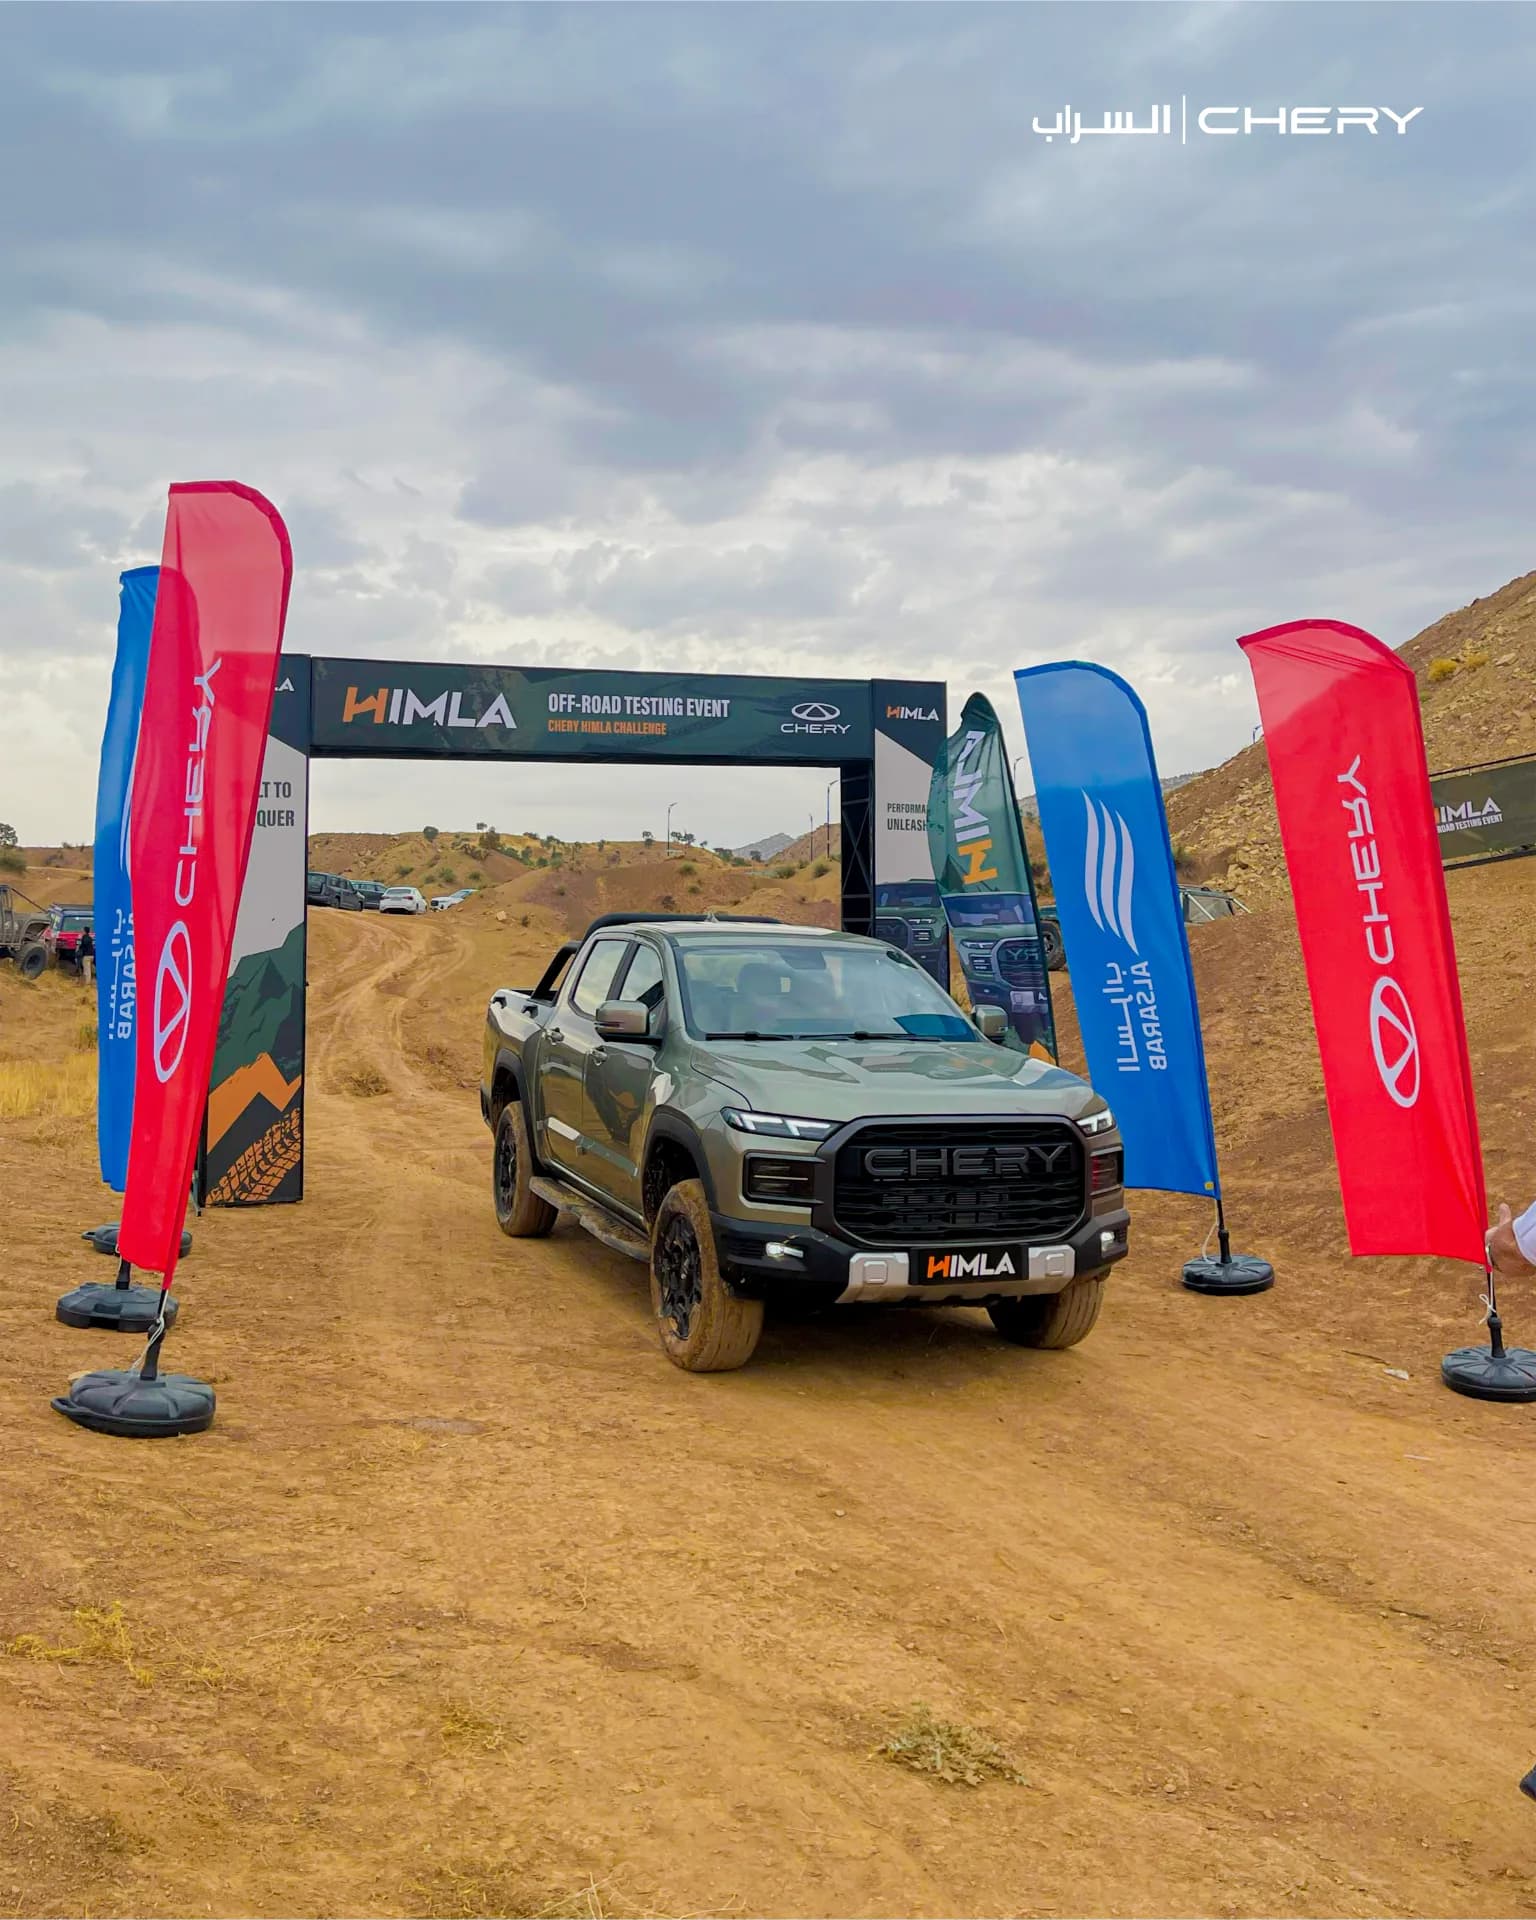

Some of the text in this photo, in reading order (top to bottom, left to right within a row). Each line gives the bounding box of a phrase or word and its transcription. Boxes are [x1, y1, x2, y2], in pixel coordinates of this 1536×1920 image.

[342, 686, 518, 729] HIMLA
[548, 693, 731, 718] OFF-ROAD TESTING EVENT
[886, 705, 940, 722] HIMLA
[547, 719, 667, 736] CHERY HIMLA CHALLENGE
[780, 723, 852, 735] CHERY
[273, 782, 292, 798] TO
[887, 803, 928, 814] PERFORMA
[1455, 818, 1483, 831] TESTING
[1482, 813, 1503, 826] EVENT
[864, 1145, 1068, 1177] CHERY
[927, 1253, 1016, 1280] HIMLA
